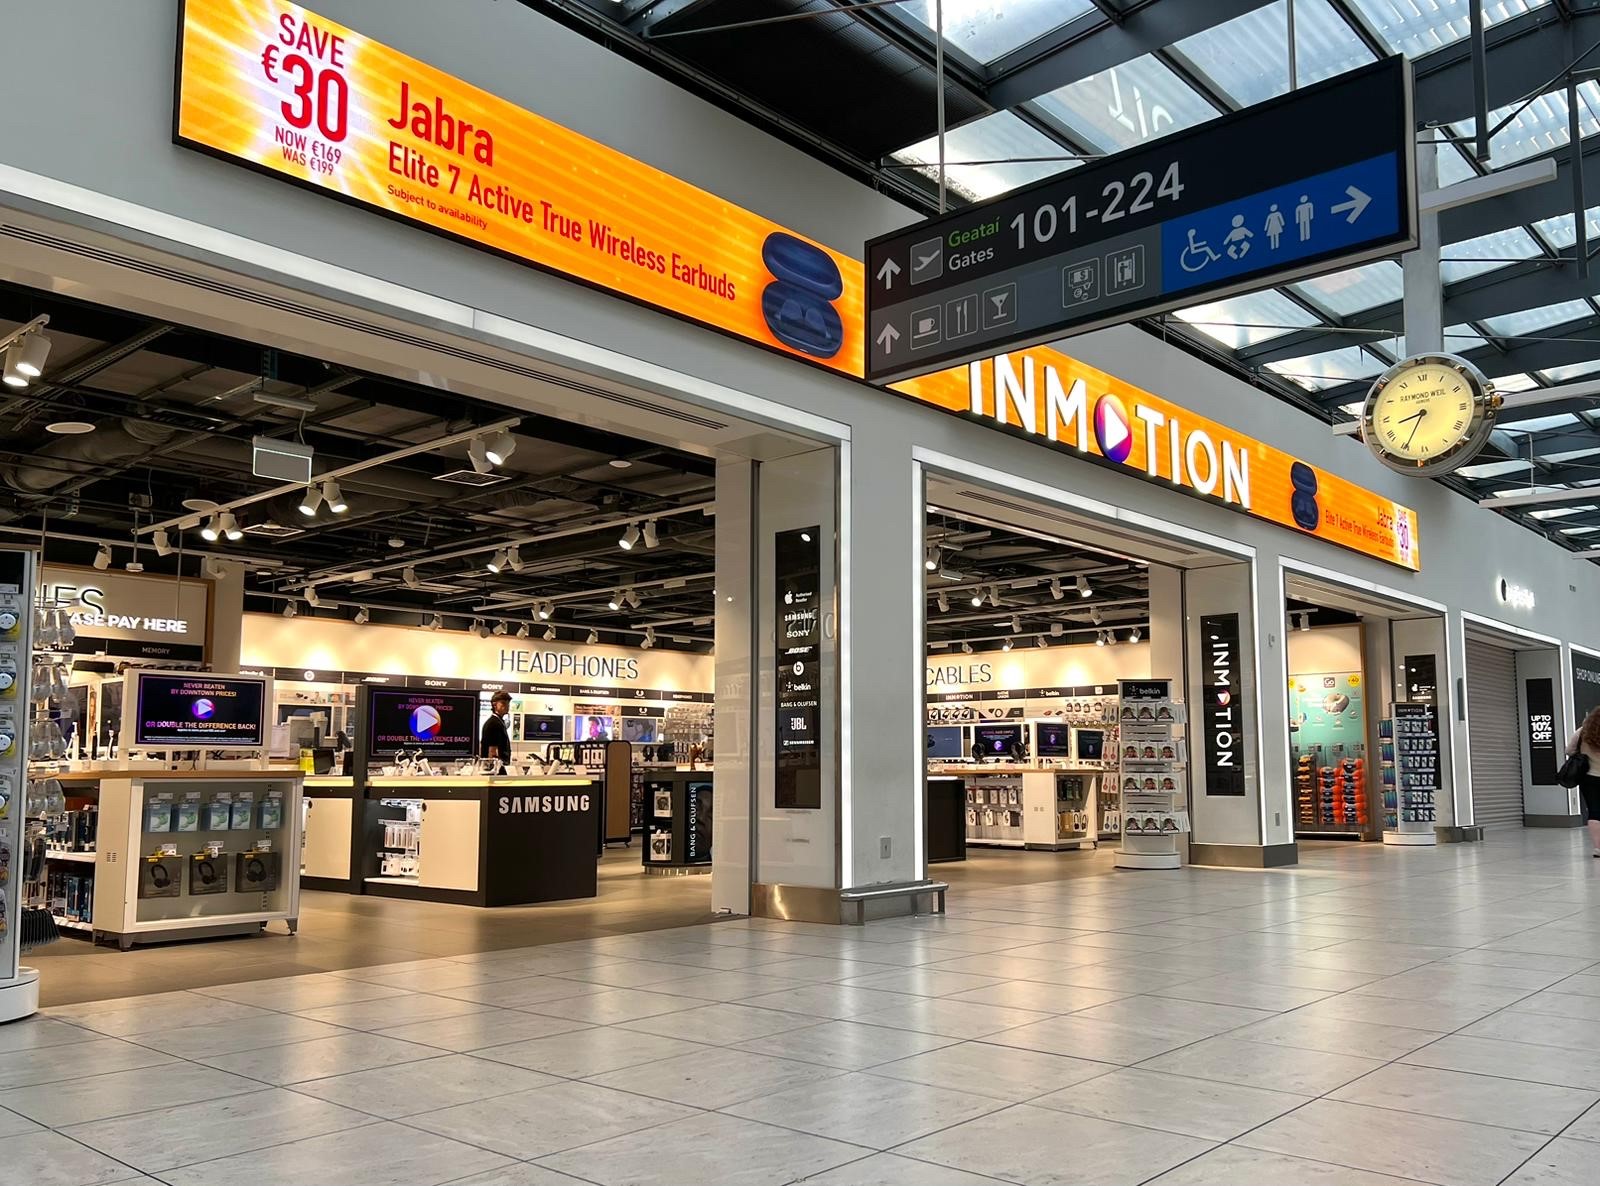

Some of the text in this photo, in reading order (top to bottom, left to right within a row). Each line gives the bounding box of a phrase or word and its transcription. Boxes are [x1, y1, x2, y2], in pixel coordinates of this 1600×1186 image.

[279, 13, 345, 69] SAVE
[261, 43, 348, 143] €30
[387, 80, 494, 167] Jabra
[275, 126, 342, 165] NOW €169
[282, 147, 334, 176] WAS €199
[387, 183, 488, 231] Subject to availability
[1010, 160, 1185, 250] 101-224
[388, 140, 736, 301] Elite 7 Active True Wireless Earbuds
[948, 215, 1000, 248] Geataí
[949, 246, 994, 272] Gates
[107, 613, 140, 631] PAY
[143, 617, 188, 634] HERE
[786, 629, 810, 638] SONY
[500, 649, 639, 681] HEADPHONES
[424, 679, 448, 687] SONY
[793, 682, 811, 691] belkin
[1139, 687, 1161, 695] belkin
[790, 717, 807, 731] JBL
[1530, 721, 1552, 731] 10%
[1532, 731, 1552, 740] OFF
[498, 794, 590, 814] SAMSUNG
